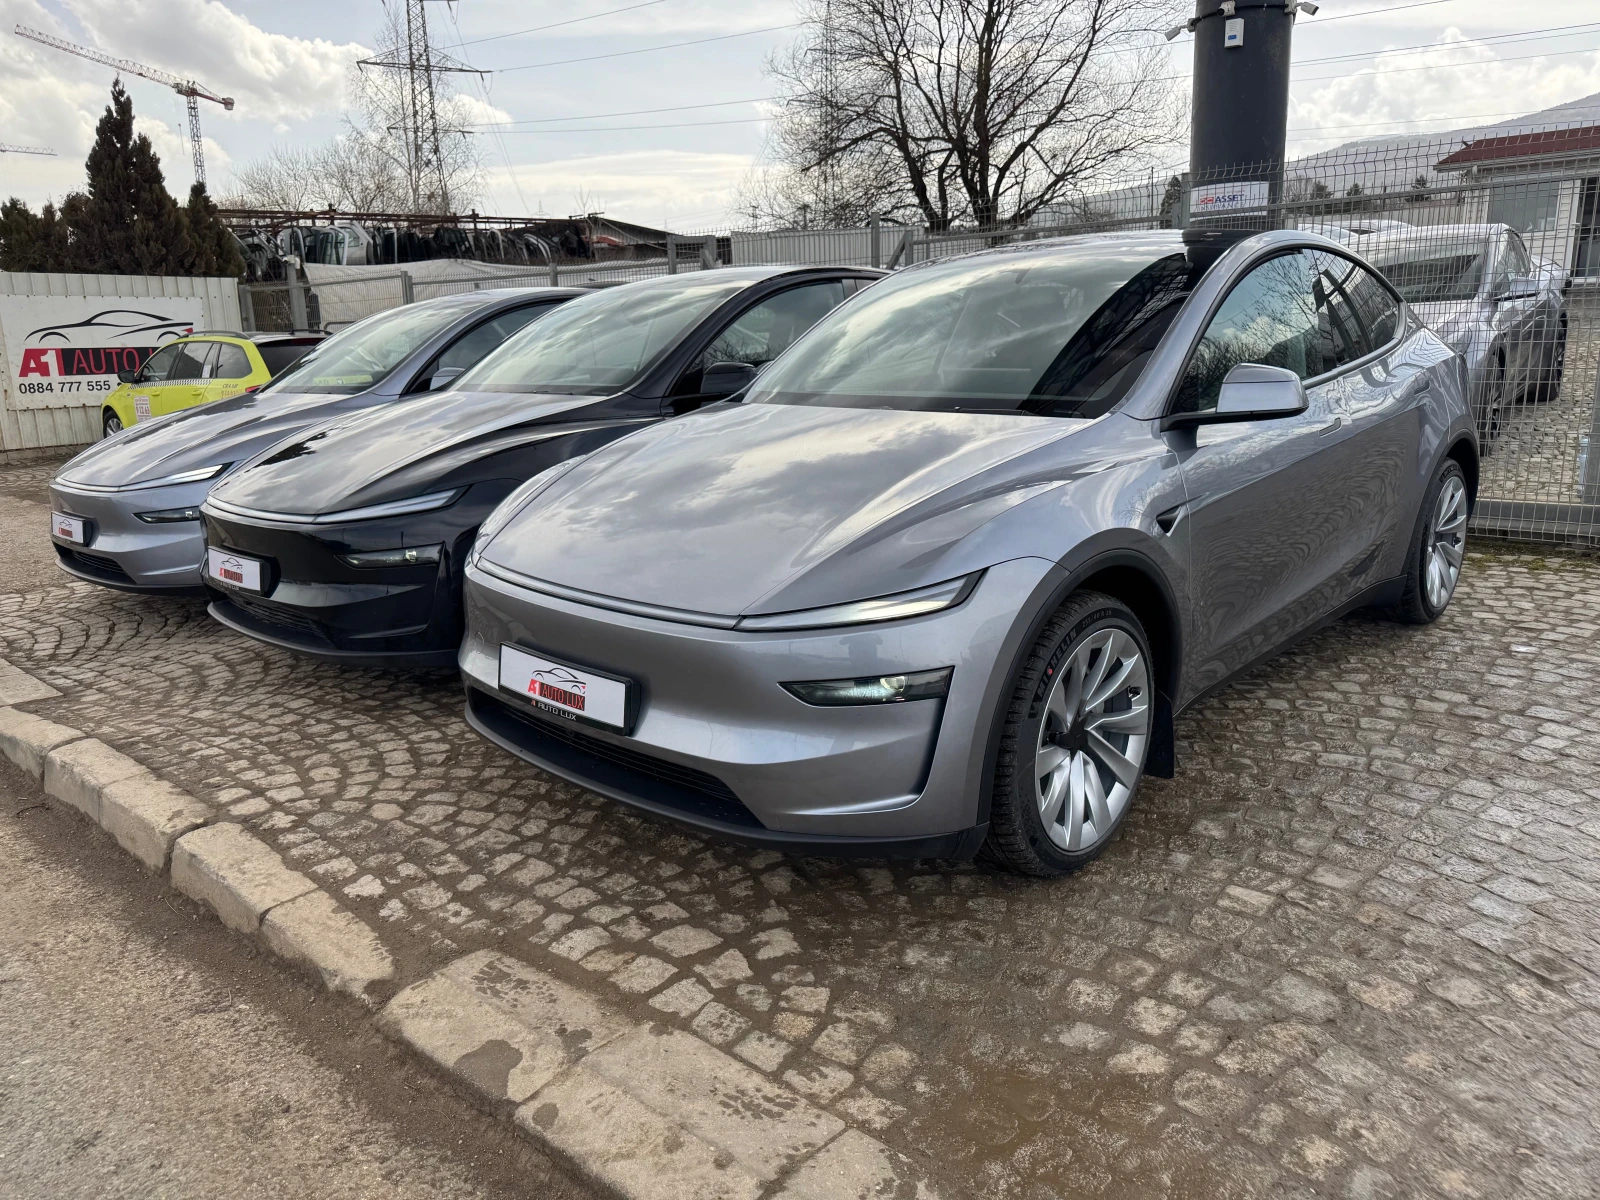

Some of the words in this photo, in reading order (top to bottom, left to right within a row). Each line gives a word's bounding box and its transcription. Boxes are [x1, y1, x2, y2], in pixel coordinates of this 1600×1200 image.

[1215, 193, 1245, 204] ASSET
[19, 348, 65, 377] A1
[73, 347, 140, 375] AUTO
[19, 382, 54, 394] 0884
[58, 381, 82, 393] 777
[87, 380, 111, 391] 555
[528, 678, 541, 697] A1
[541, 684, 564, 704] AUTO
[566, 690, 585, 711] LUX
[538, 702, 558, 714] AUTO
[560, 709, 577, 721] LUX
